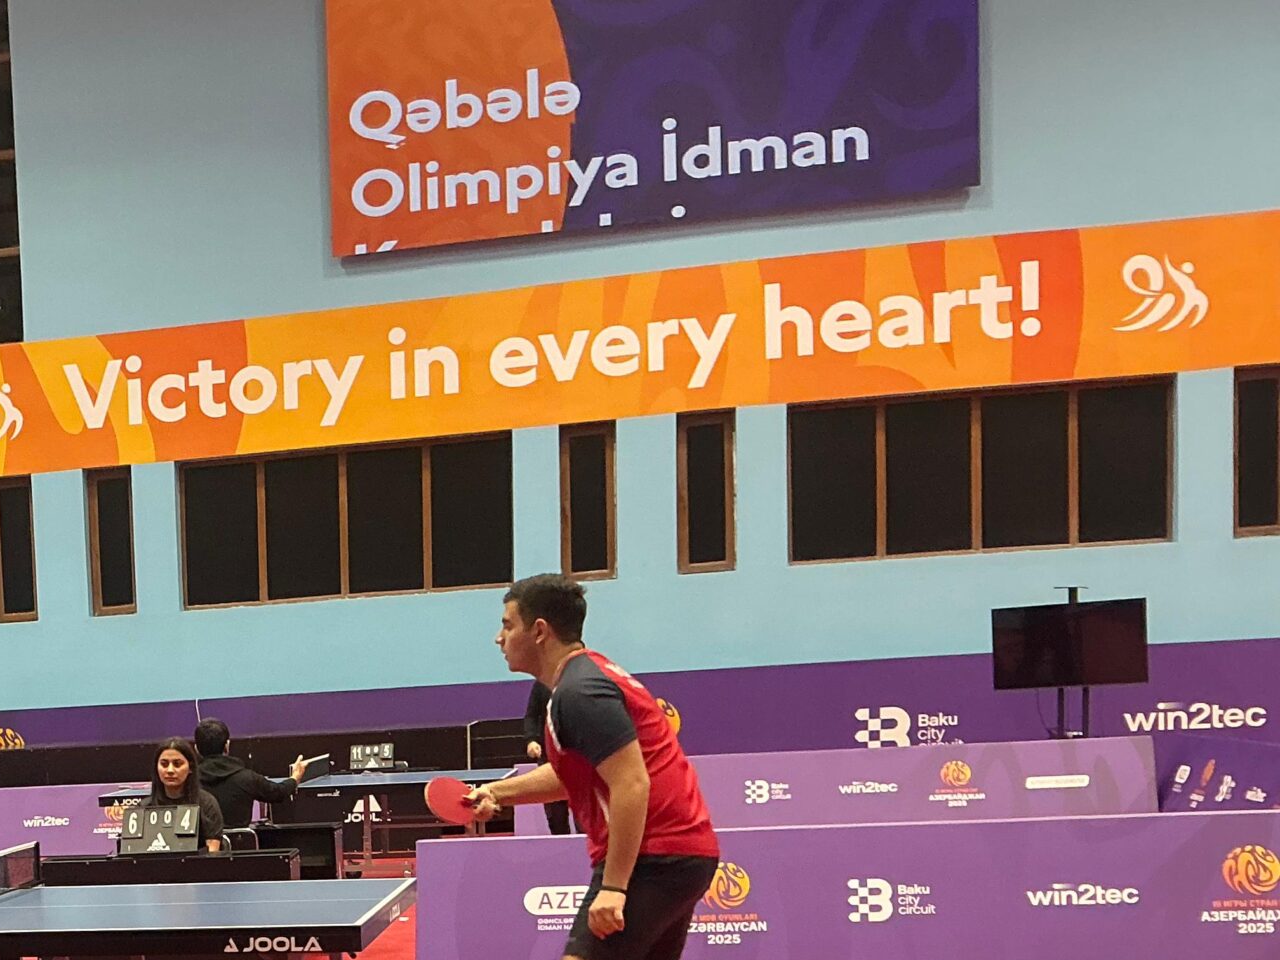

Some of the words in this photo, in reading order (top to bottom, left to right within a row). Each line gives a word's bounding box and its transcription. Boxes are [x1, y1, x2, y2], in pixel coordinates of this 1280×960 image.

[349, 68, 581, 150] Qəbələ
[351, 145, 639, 217] Olimpiya
[662, 118, 870, 182] İdman
[63, 352, 364, 431] Victory
[388, 326, 460, 400] in
[488, 312, 737, 390] every
[762, 259, 1042, 361] heart!
[918, 711, 959, 728] Baku
[1123, 702, 1268, 733] win2tec
[917, 726, 946, 744] city
[838, 781, 898, 794] win2tec
[23, 816, 70, 828] win2tec
[128, 812, 138, 834] 6
[150, 811, 158, 824] 0
[163, 810, 172, 823] 0
[180, 809, 191, 831] 4
[897, 884, 931, 895] Baku
[1026, 883, 1140, 906] win2tec
[897, 895, 920, 908] city
[898, 904, 937, 915] circuit
[687, 920, 768, 933] ZƏRBAYCAN
[1238, 922, 1275, 934] 2025
[242, 936, 323, 953] JOOLA
[707, 934, 741, 945] 2025
